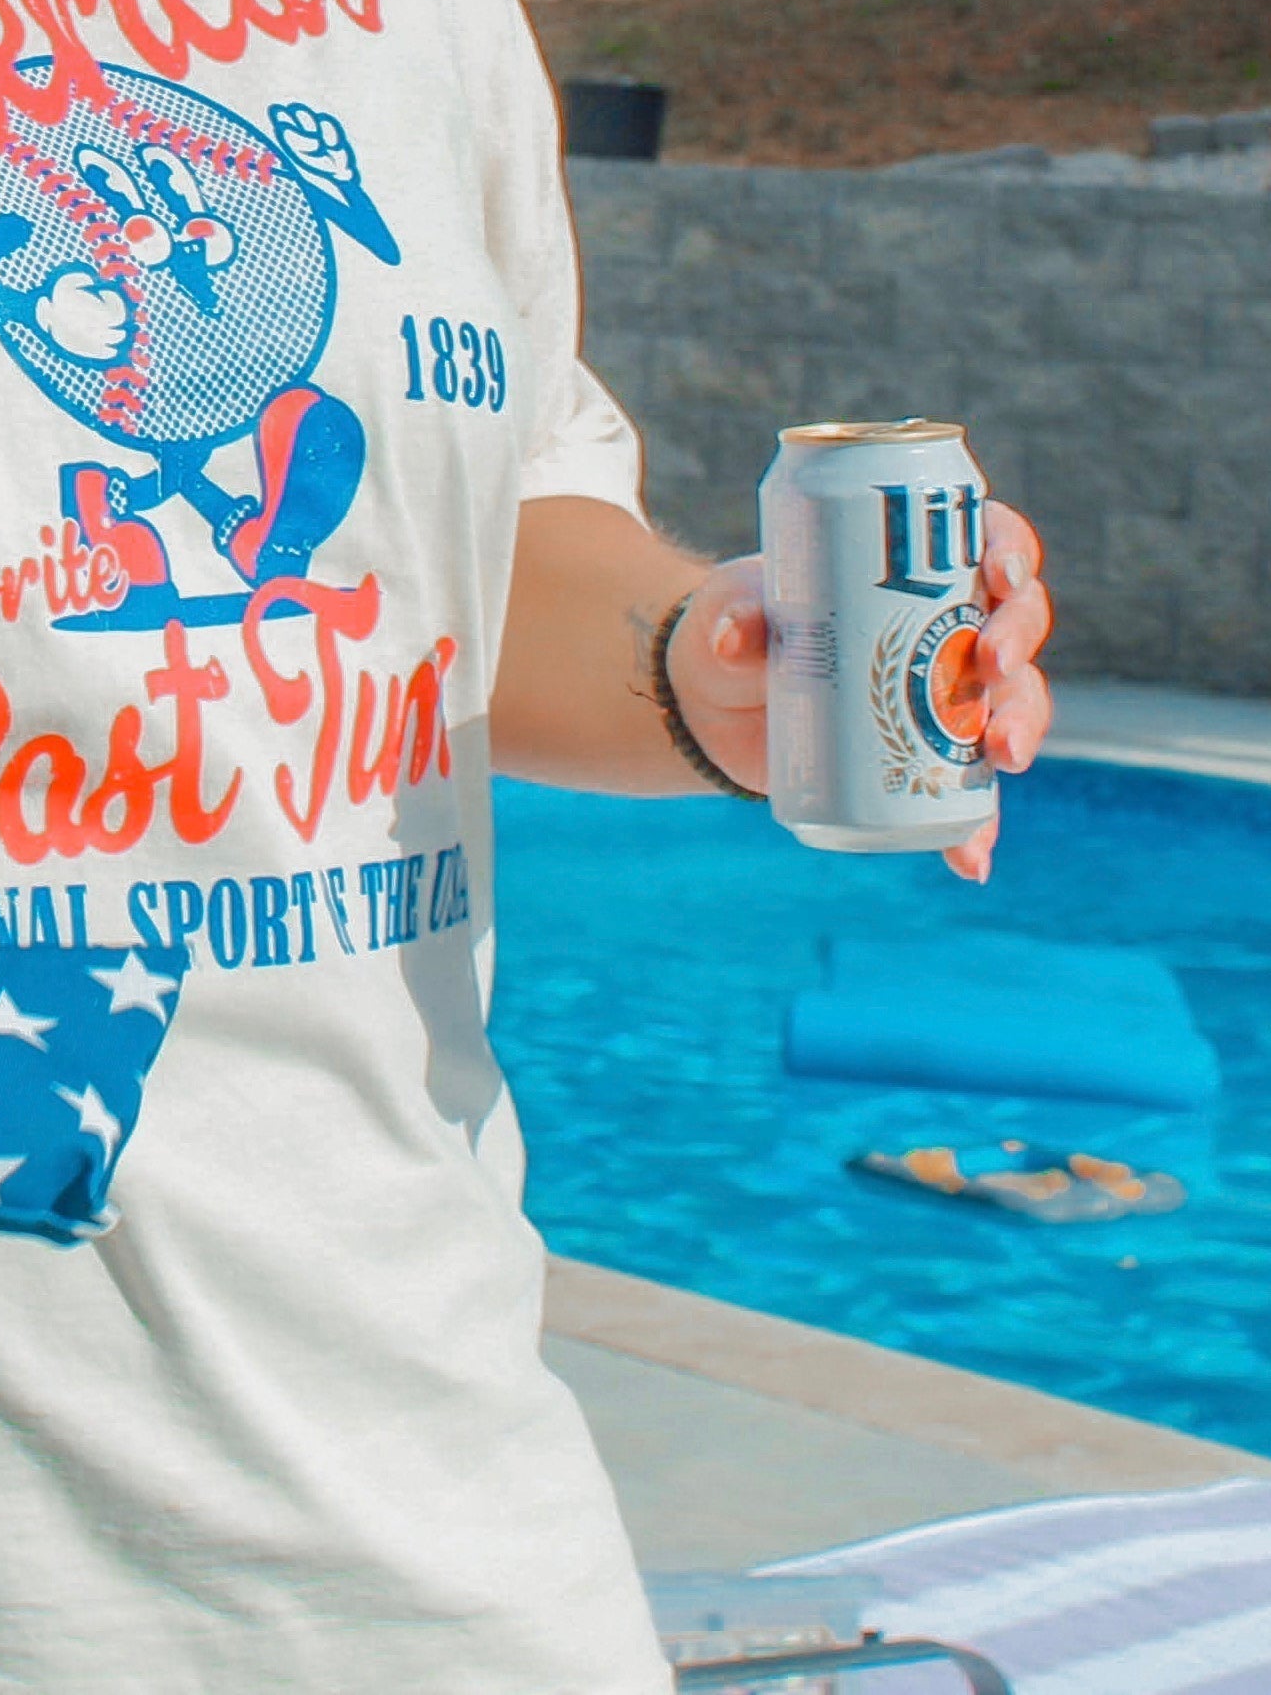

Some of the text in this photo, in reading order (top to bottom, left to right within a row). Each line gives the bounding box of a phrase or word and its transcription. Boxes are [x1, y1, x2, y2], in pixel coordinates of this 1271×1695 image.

[399, 313, 507, 413] 1839
[871, 485, 983, 599] Lit
[910, 662, 926, 678] A
[127, 870, 317, 971] SPORT
[359, 853, 424, 951] THE
